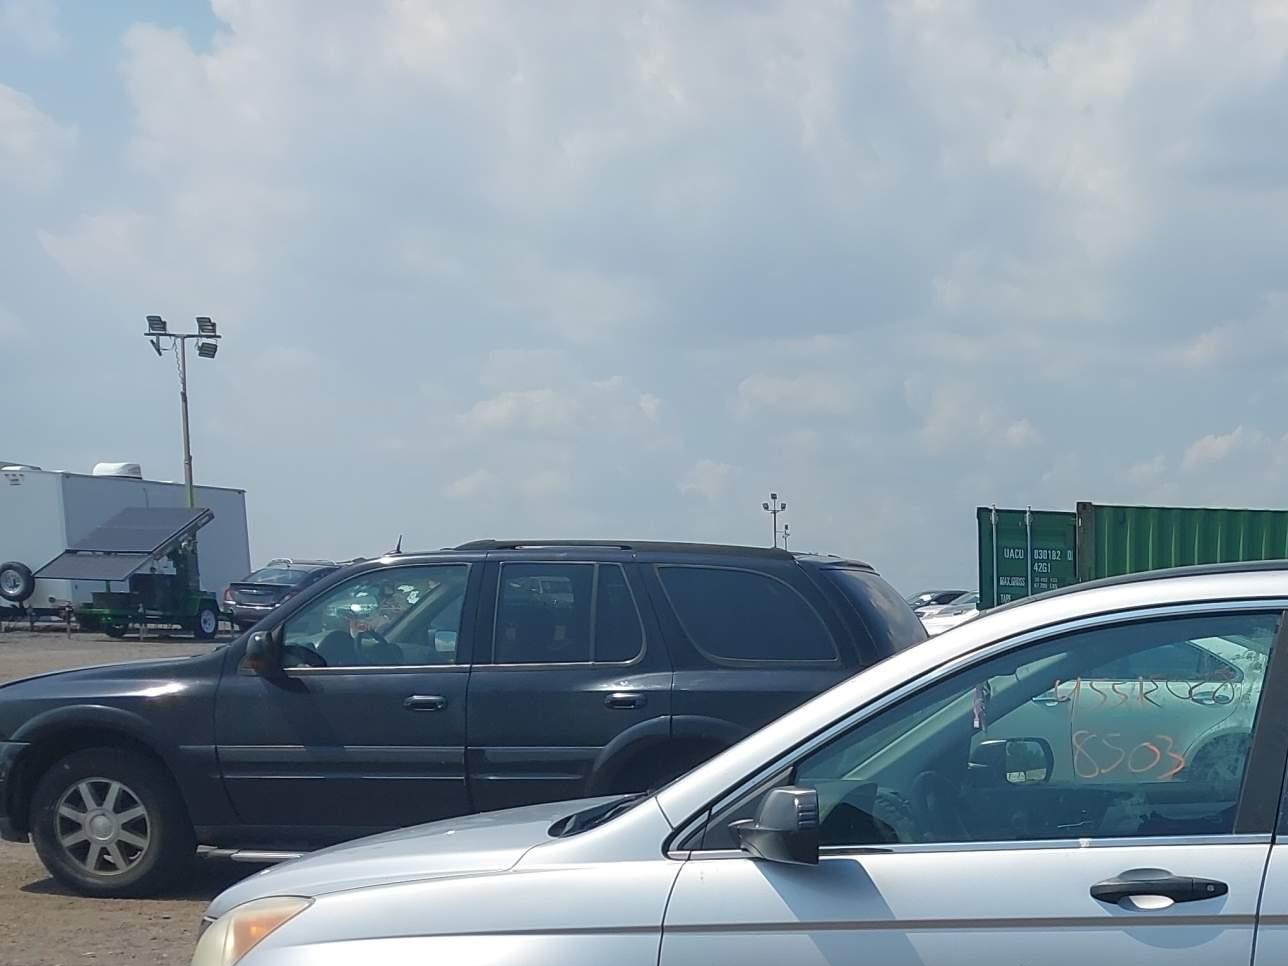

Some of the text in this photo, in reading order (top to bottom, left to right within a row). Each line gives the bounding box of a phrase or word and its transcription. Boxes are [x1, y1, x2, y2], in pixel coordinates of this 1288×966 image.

[1004, 548, 1024, 559] UACU
[1033, 562, 1051, 573] 42G1
[1072, 730, 1185, 779] 8503
